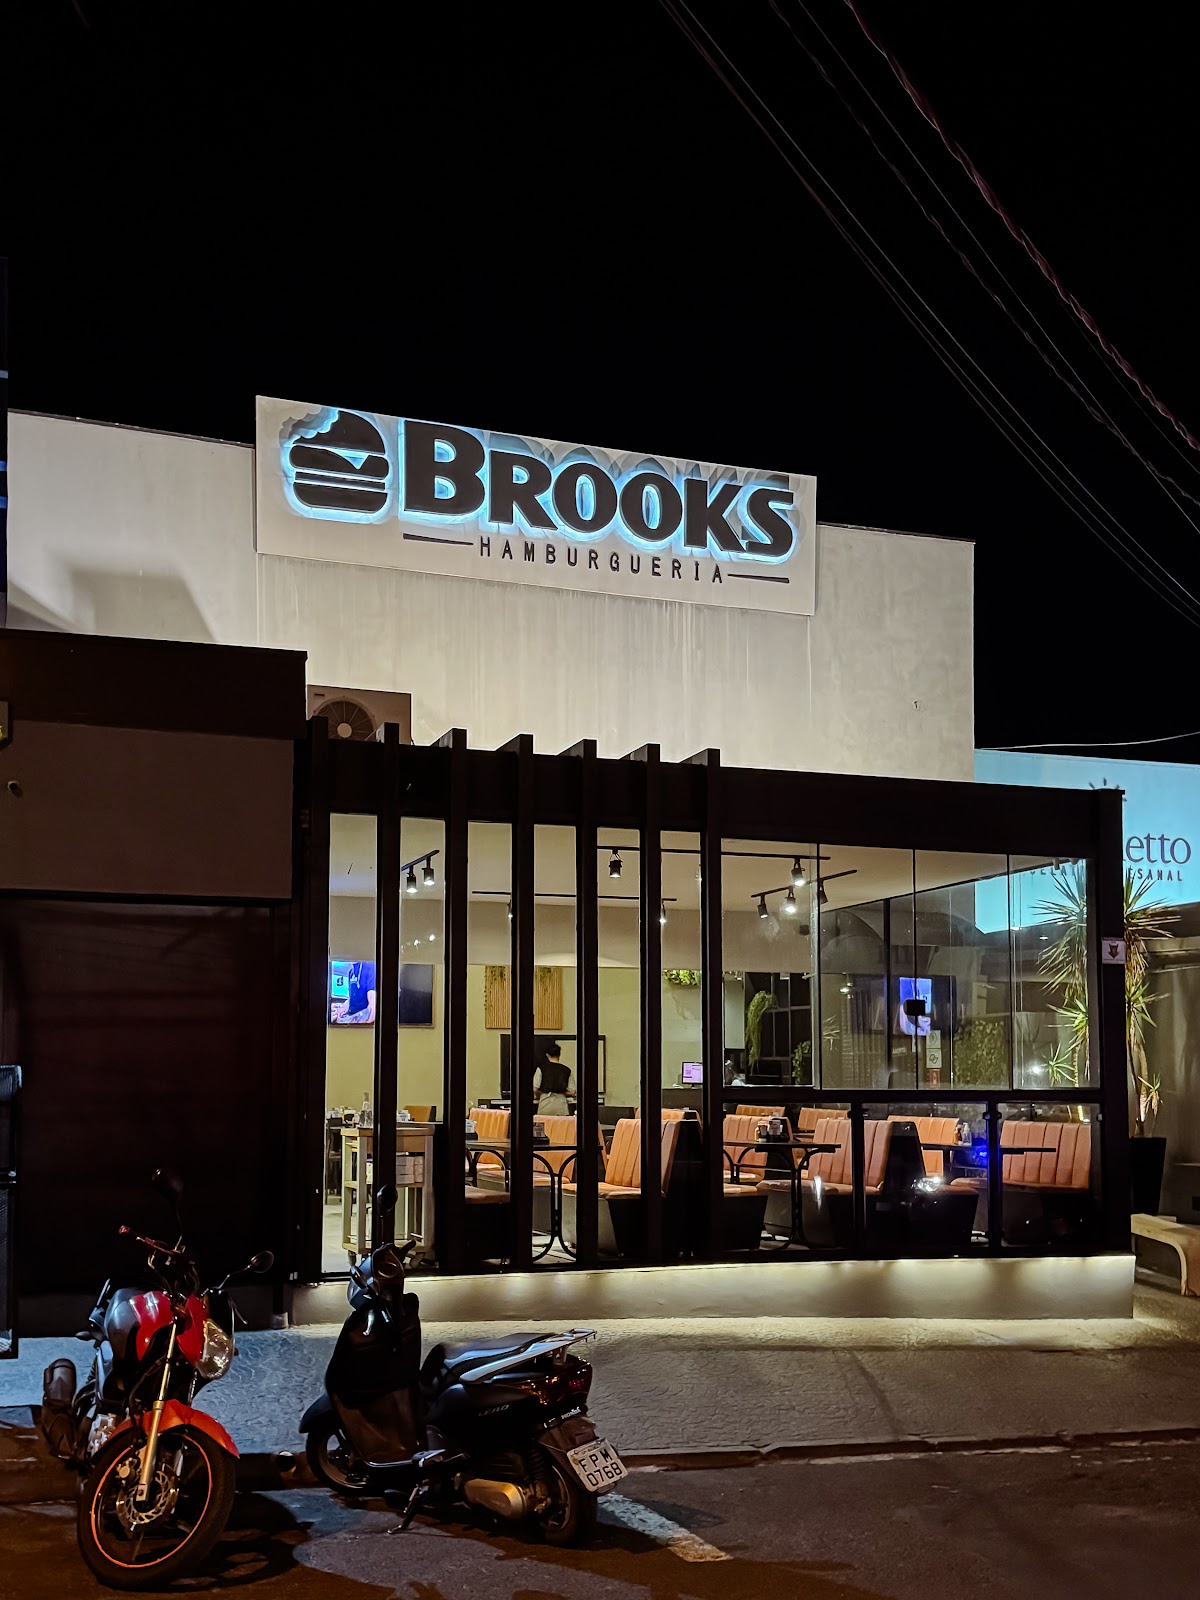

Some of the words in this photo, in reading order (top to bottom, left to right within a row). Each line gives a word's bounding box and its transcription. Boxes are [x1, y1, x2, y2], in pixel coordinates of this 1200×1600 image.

[403, 420, 794, 558] BROOKS
[480, 536, 723, 584] HAMBURGUERIA
[1123, 833, 1191, 864] etto
[1127, 867, 1183, 882] ESANAL
[578, 1448, 613, 1473] FPM
[586, 1462, 623, 1487] 0768
